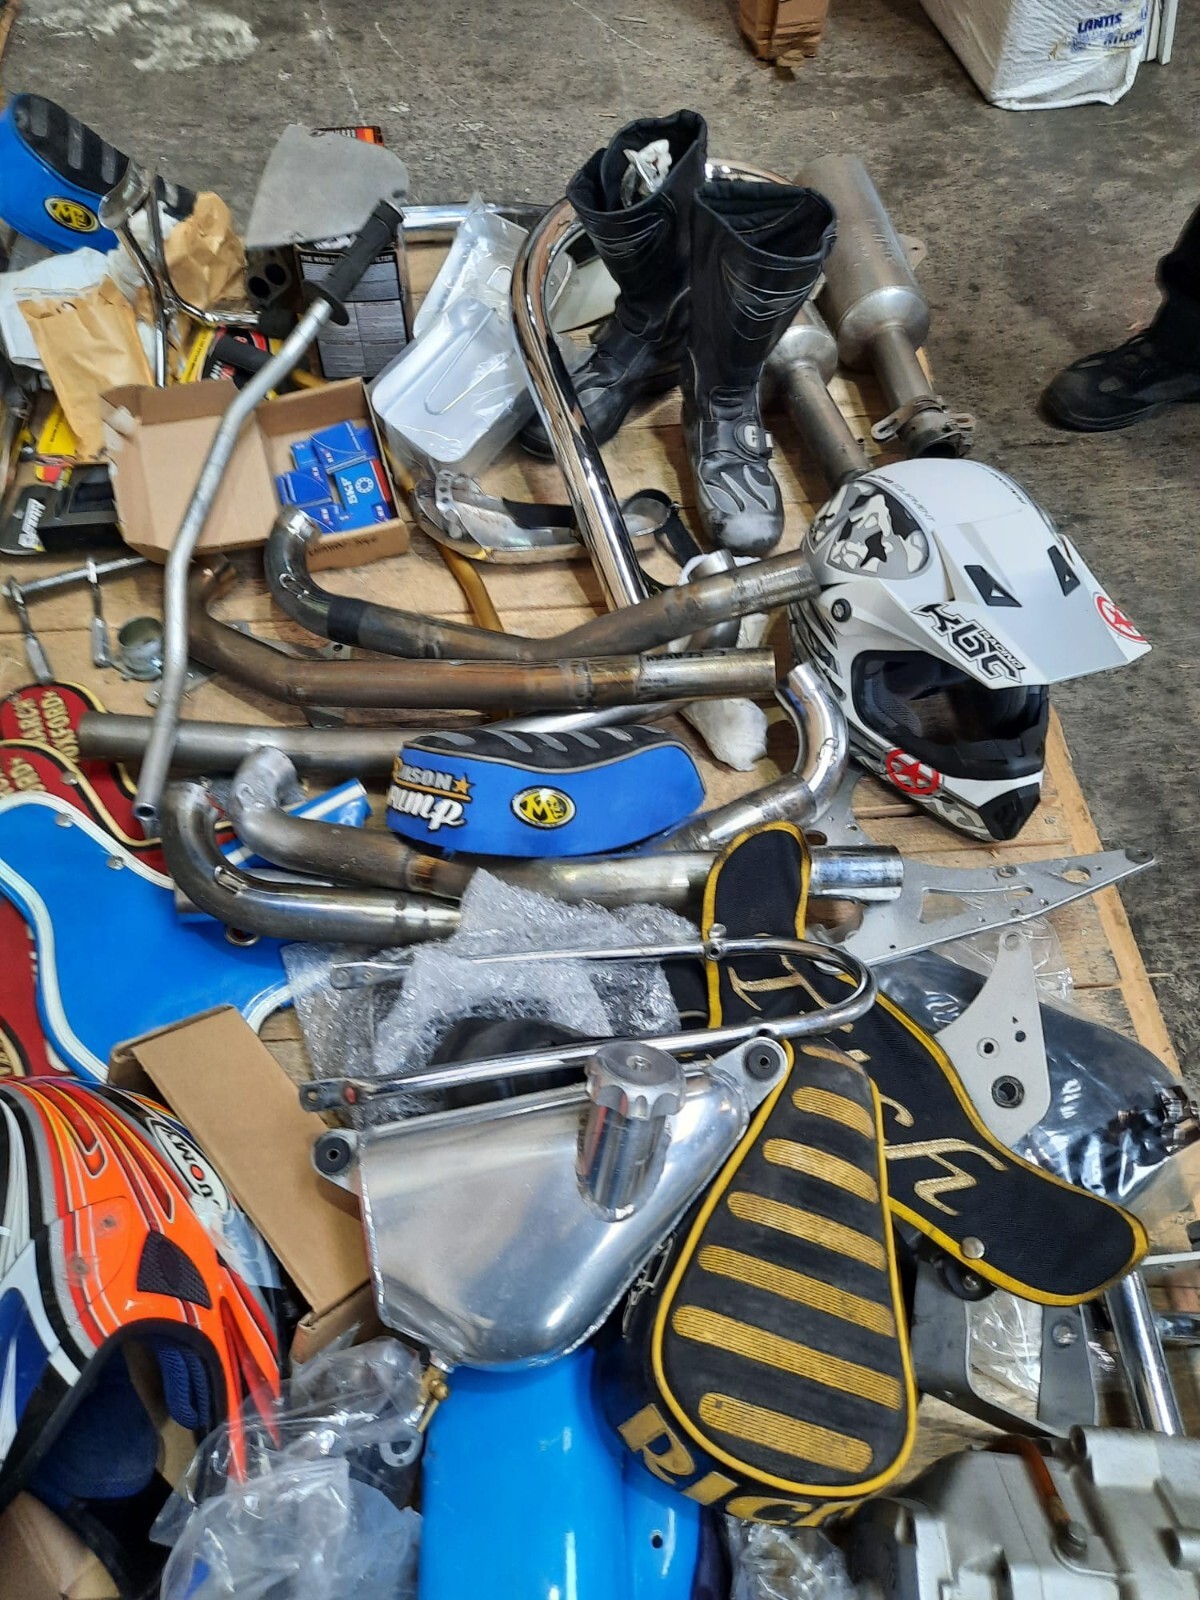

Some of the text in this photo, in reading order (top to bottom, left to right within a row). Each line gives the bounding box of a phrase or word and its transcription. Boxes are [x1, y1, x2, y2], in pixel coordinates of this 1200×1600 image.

[340, 476, 358, 505] SKF
[978, 629, 1025, 670] RACING
[158, 1123, 223, 1209] UOMY
